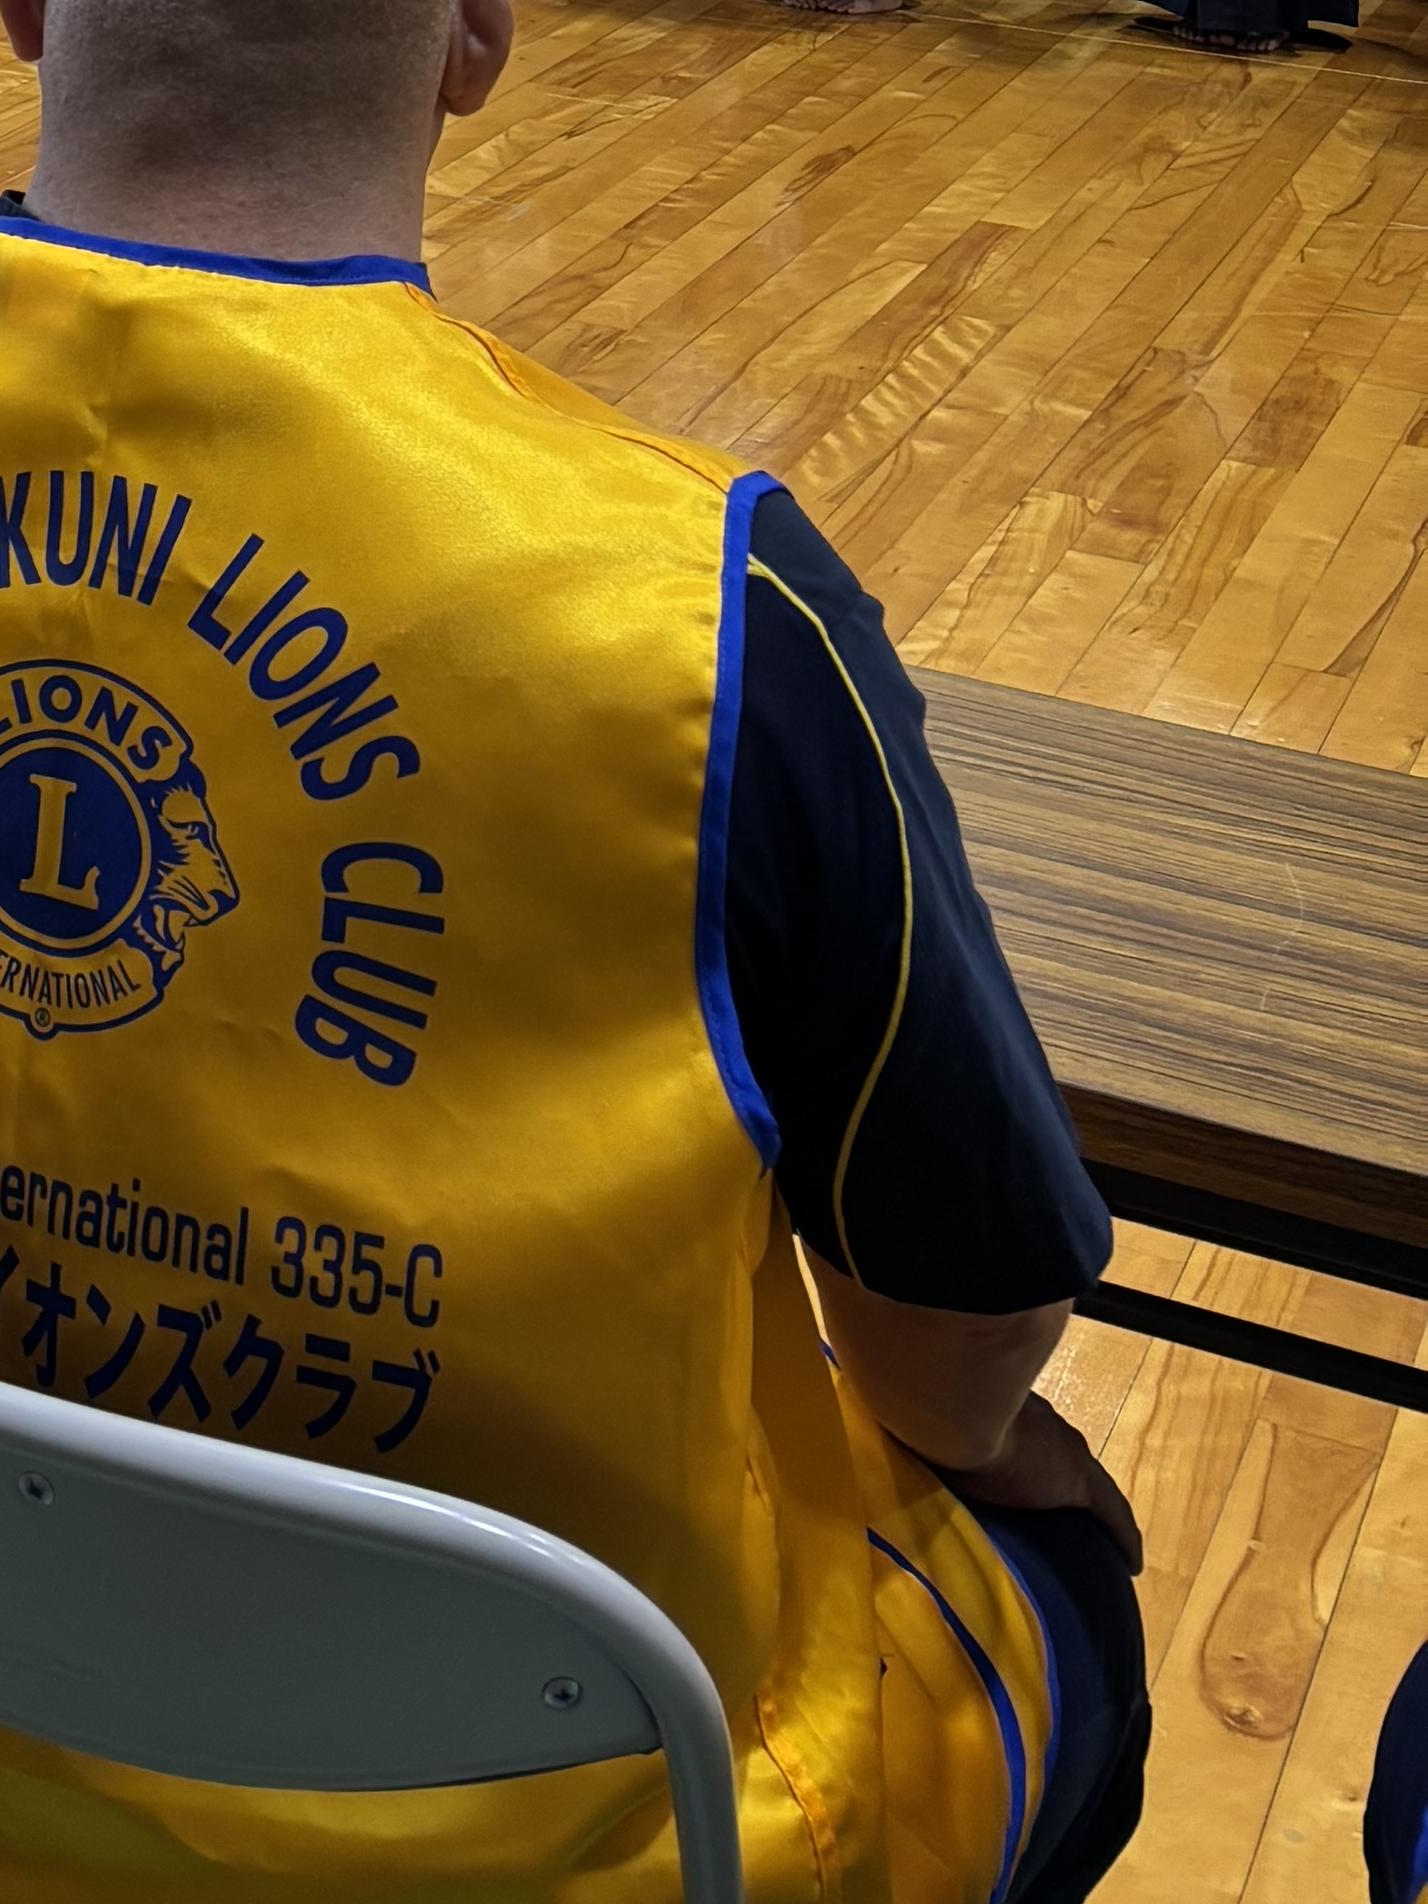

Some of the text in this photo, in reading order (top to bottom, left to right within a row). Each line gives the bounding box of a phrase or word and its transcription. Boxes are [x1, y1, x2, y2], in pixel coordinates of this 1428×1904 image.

[186, 531, 422, 803] LIONS
[17, 772, 101, 913] L
[292, 840, 446, 1089] CLUB
[270, 1215, 444, 1330] 335-C
